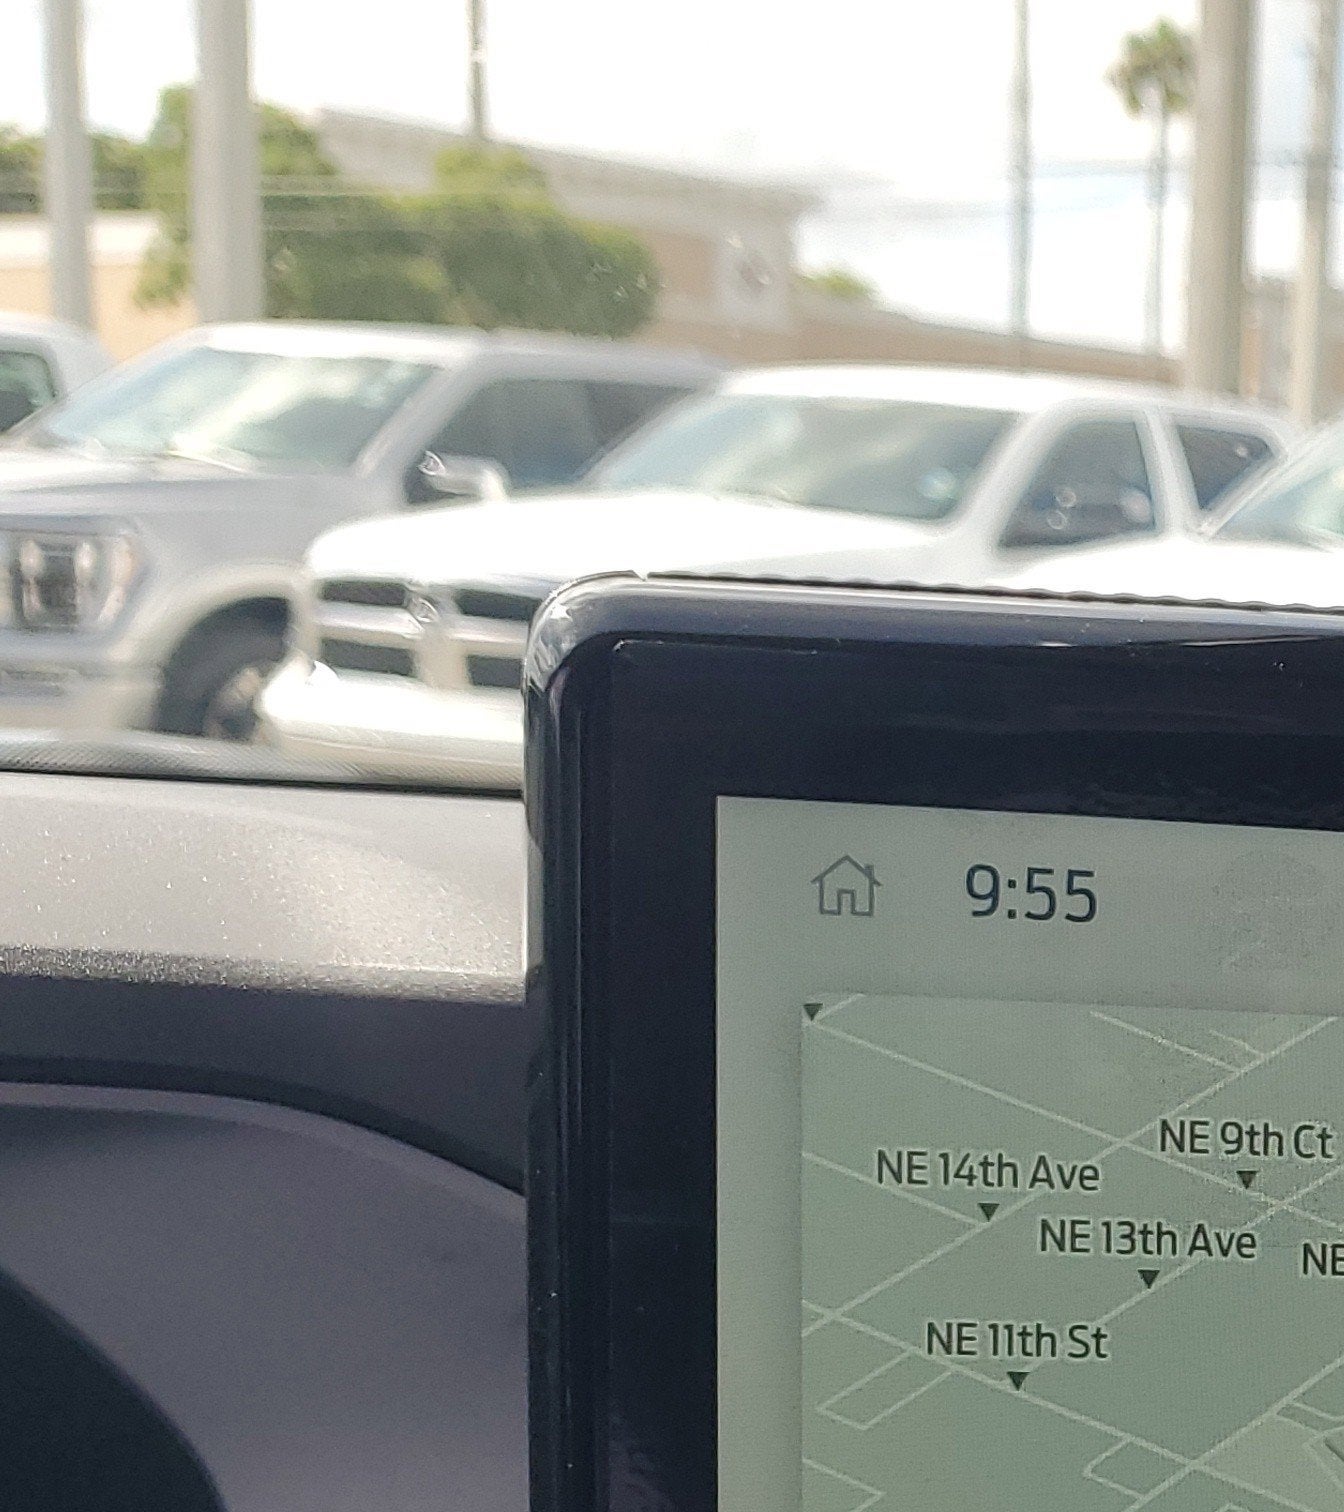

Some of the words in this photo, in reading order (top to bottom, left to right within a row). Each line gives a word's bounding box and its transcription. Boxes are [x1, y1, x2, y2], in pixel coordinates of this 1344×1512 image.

[965, 864, 1097, 923] 9:55
[1159, 1120, 1210, 1154] NE
[1220, 1123, 1283, 1157] 9th
[1293, 1126, 1333, 1159] Ct
[877, 1150, 928, 1185] NE
[938, 1152, 1018, 1188] 14th
[1028, 1156, 1100, 1191] Ave
[1040, 1220, 1091, 1254] NE
[1102, 1222, 1177, 1256] 13th
[1187, 1224, 1257, 1260] Ave
[926, 1322, 977, 1356] NE
[987, 1323, 1057, 1357] 11th
[1067, 1325, 1109, 1358] St
